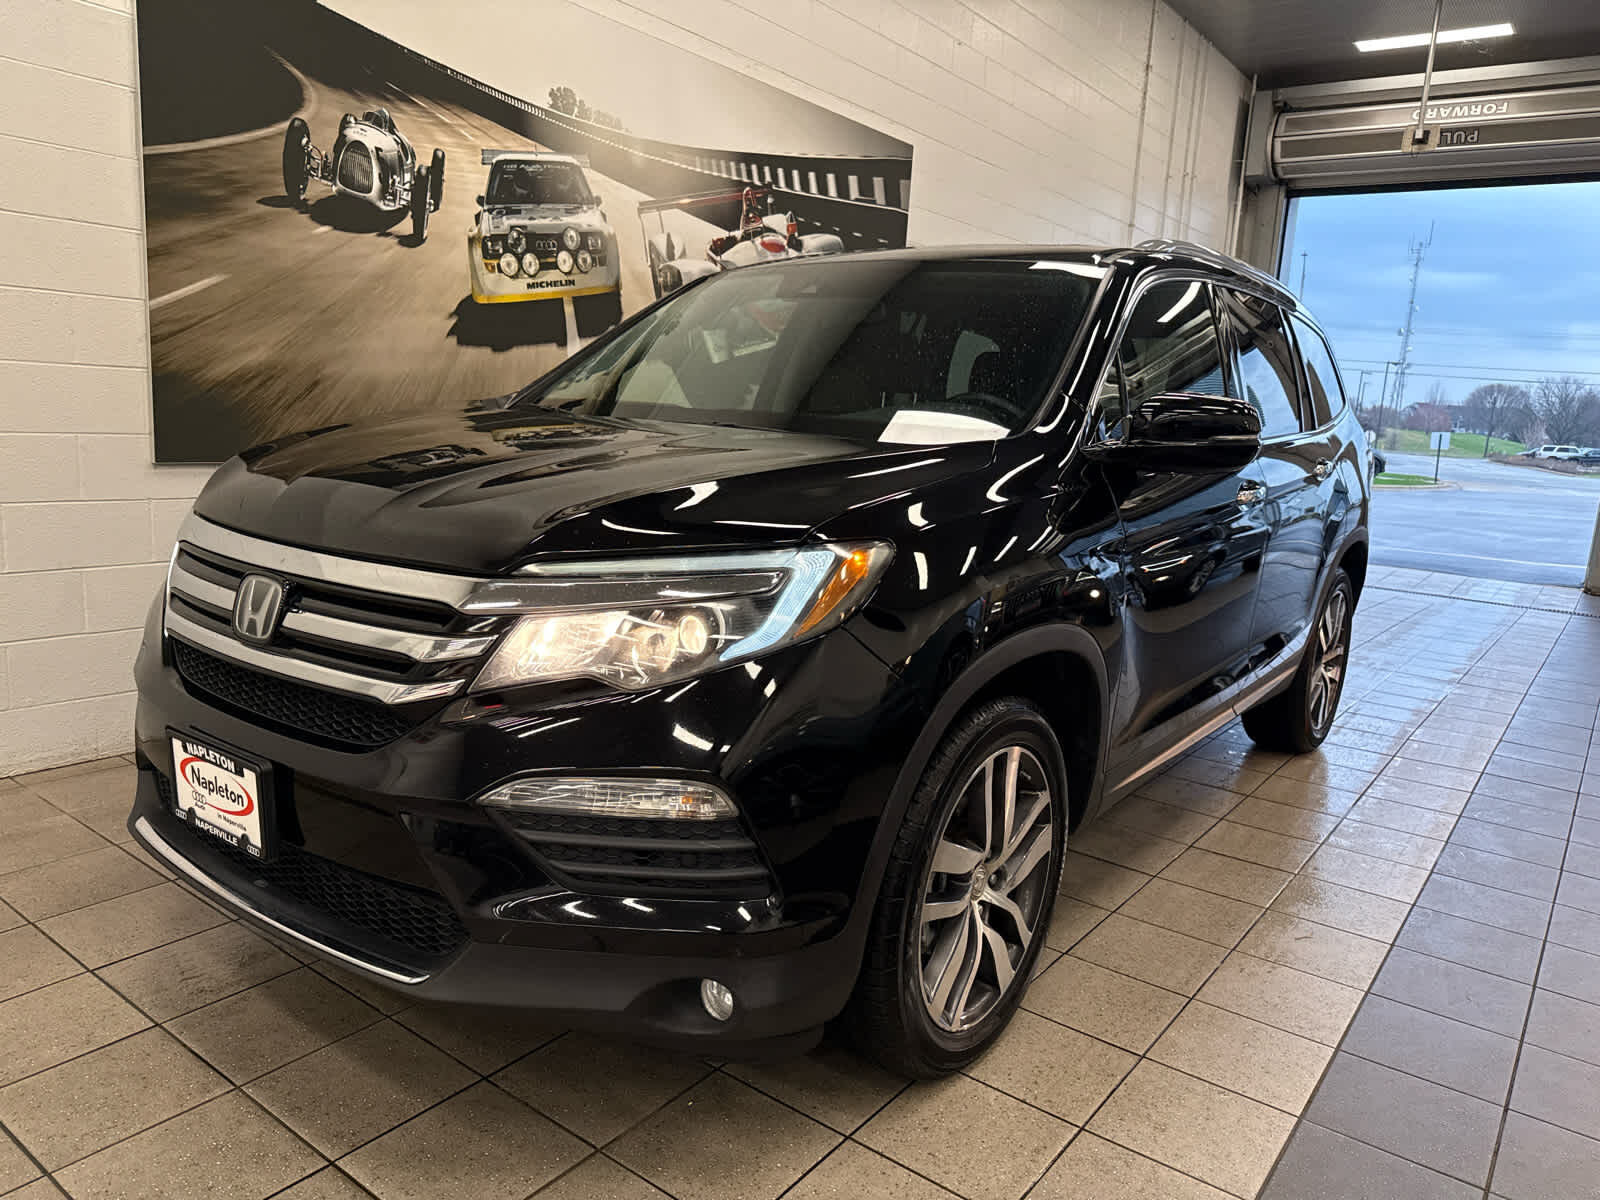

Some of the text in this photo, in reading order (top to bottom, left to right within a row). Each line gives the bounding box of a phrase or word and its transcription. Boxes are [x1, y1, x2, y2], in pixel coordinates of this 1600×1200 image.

[1412, 101, 1508, 120] FORWARD
[1442, 129, 1479, 144] PUL
[526, 279, 576, 290] MICHELIN
[185, 742, 236, 773] NAPLETON
[190, 764, 245, 808] Napleton
[195, 817, 239, 847] NAPERVILLE
